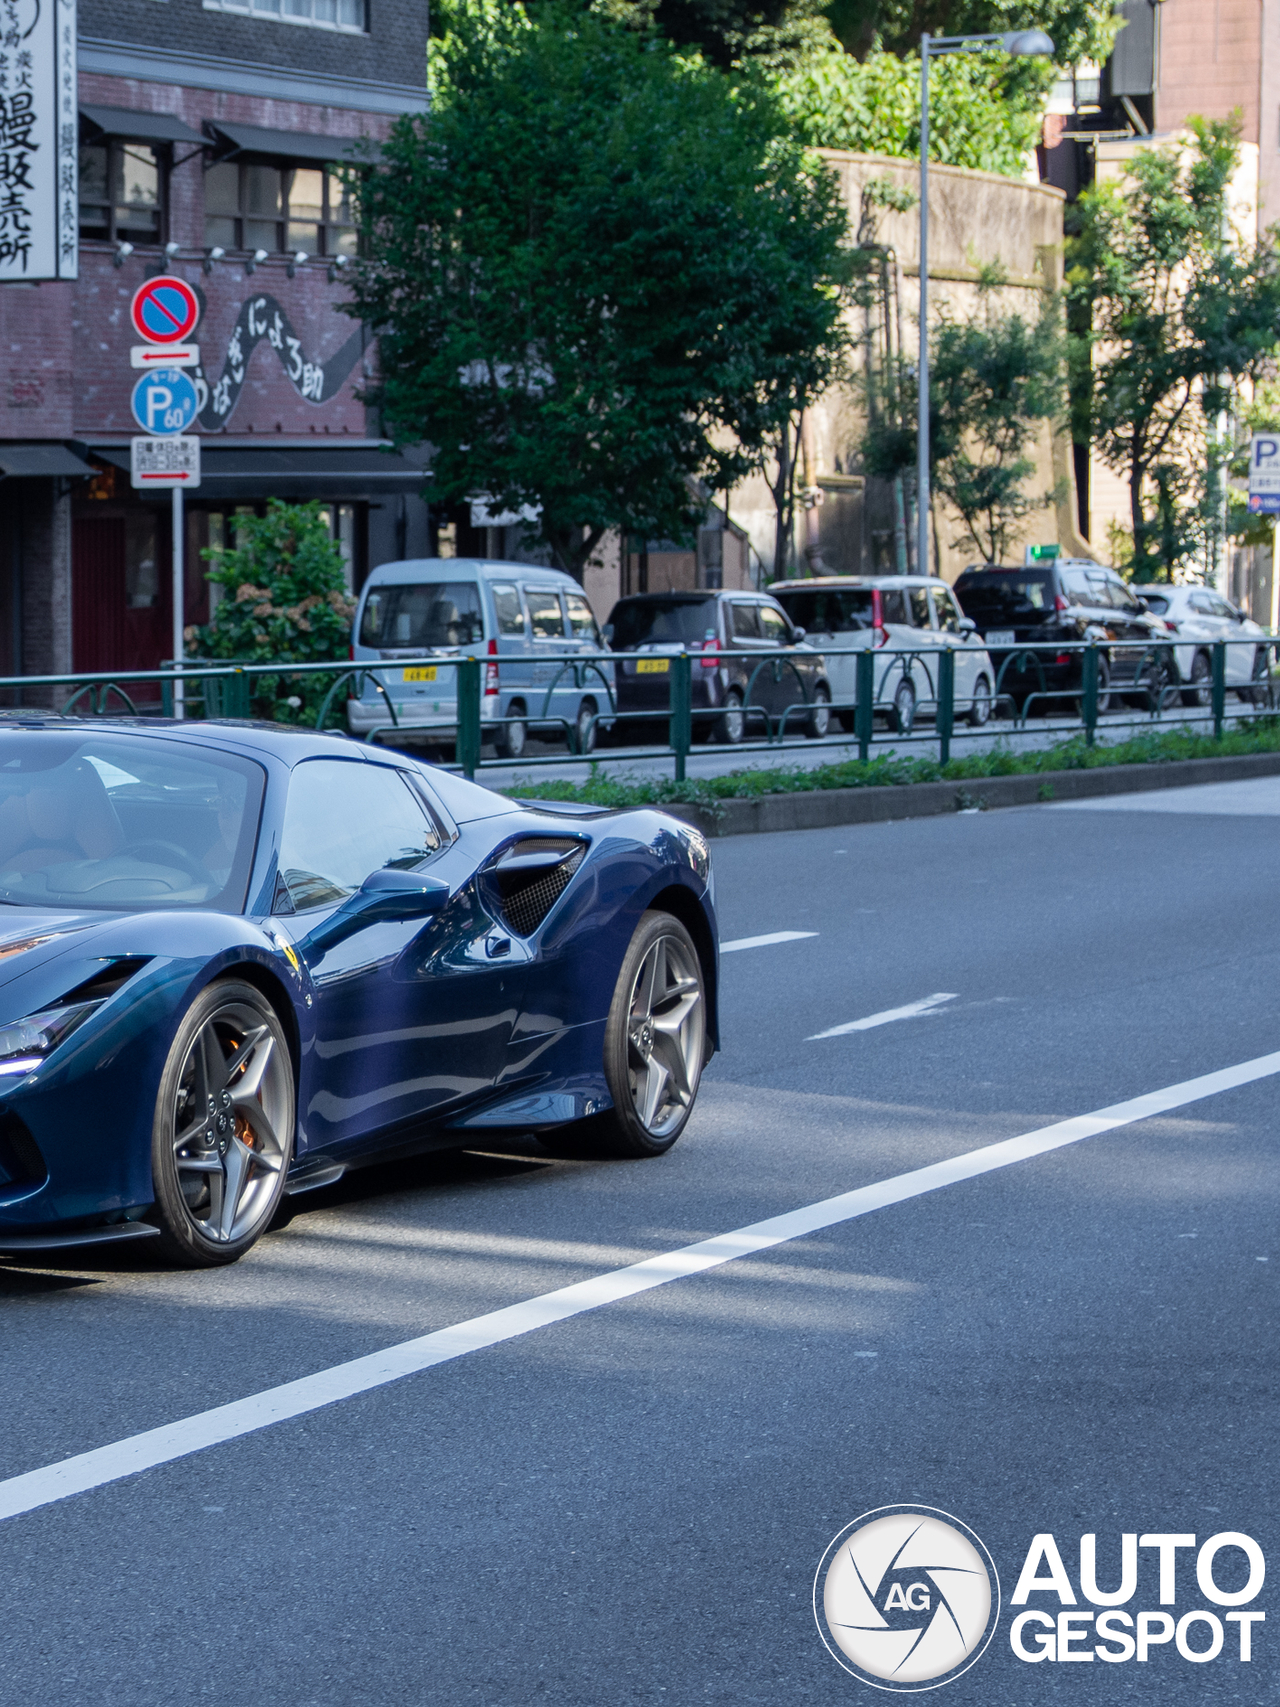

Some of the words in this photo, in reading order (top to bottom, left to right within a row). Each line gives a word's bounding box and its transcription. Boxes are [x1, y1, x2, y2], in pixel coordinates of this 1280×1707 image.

[147, 386, 173, 429] P
[164, 408, 184, 429] 60
[1256, 440, 1277, 468] P
